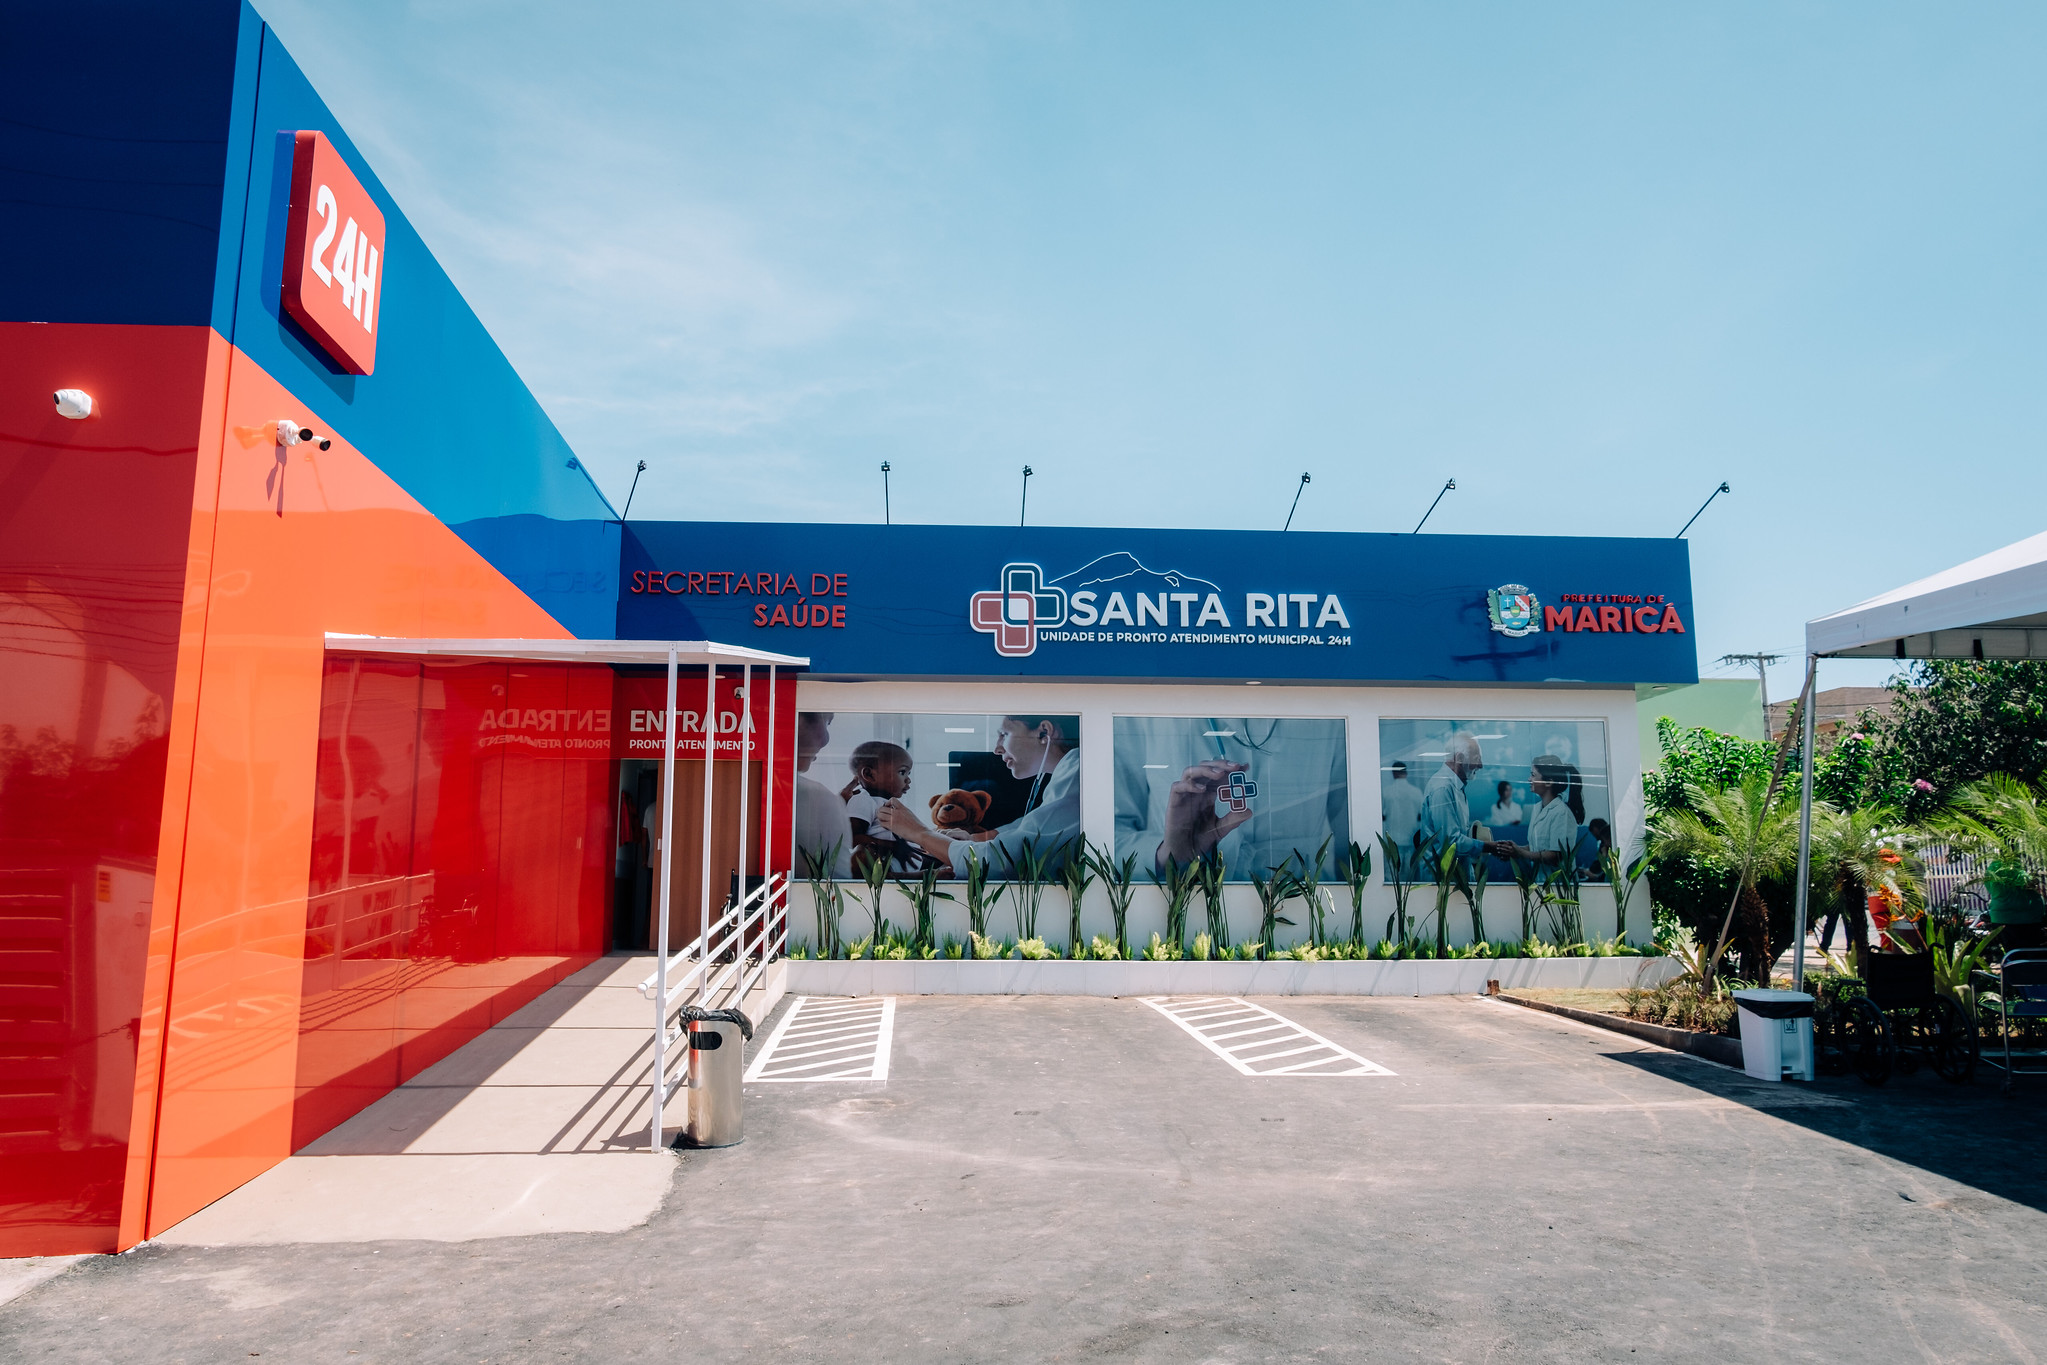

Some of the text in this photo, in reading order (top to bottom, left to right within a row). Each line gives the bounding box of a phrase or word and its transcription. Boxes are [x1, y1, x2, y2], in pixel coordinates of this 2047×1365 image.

[311, 184, 379, 335] 24H
[631, 569, 802, 596] SECRETARIA
[811, 573, 848, 597] DE
[753, 597, 846, 628] SAÚDE
[1068, 590, 1351, 629] SANTA RITA
[1562, 593, 1665, 604] PREFEITURA DE
[1545, 602, 1686, 634] MARICÁ
[1040, 631, 1352, 646] UNIDADE DE PRONTO ATENDIMENTO MUNICIPAL 24H
[629, 739, 671, 749] PRONT
